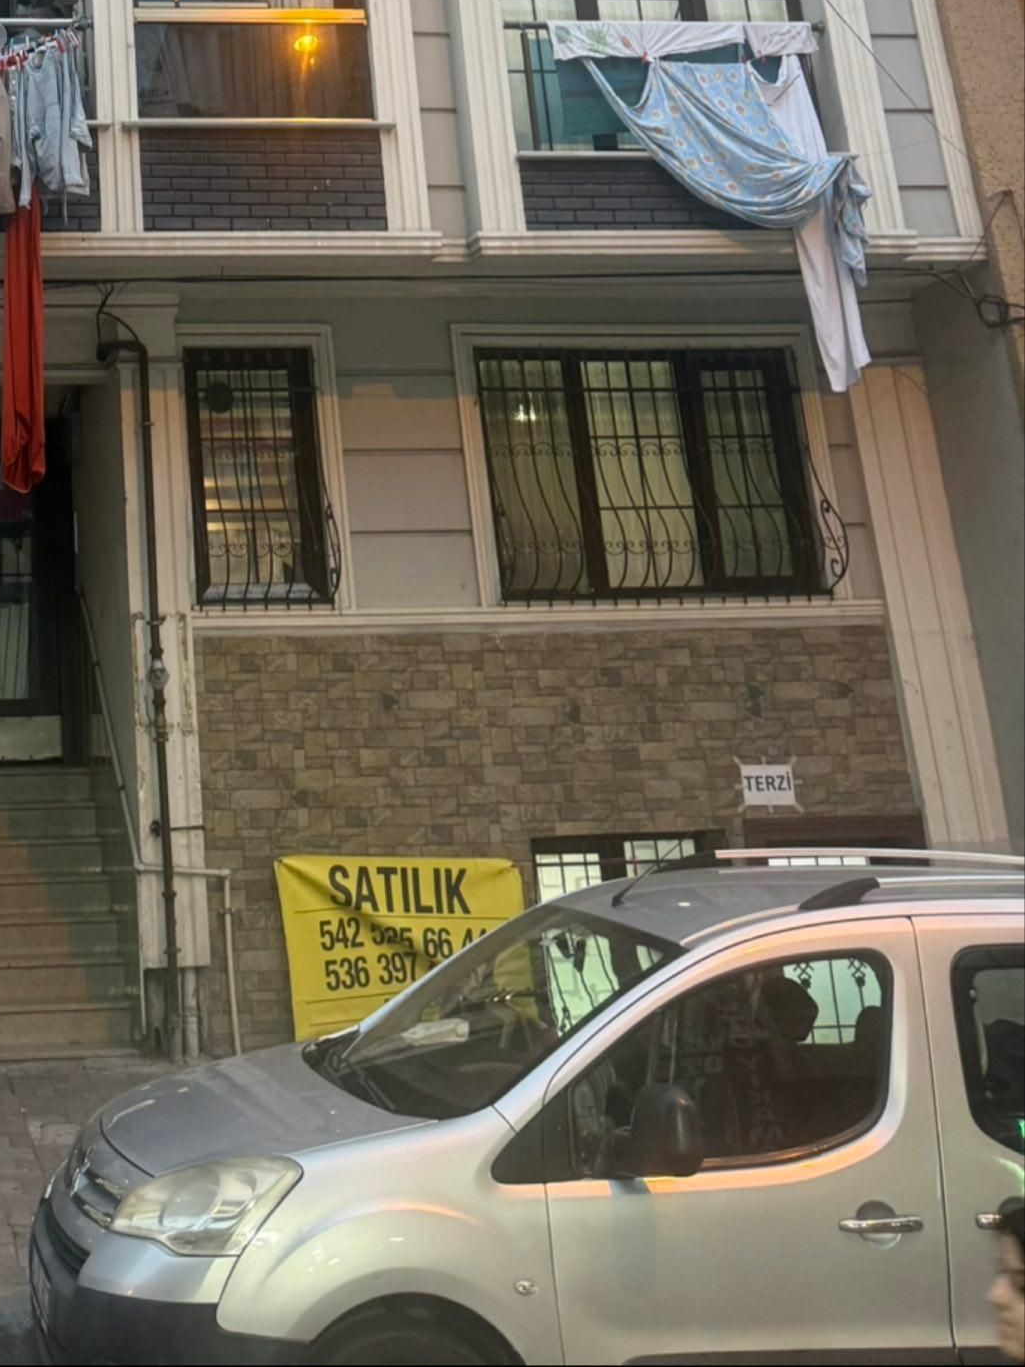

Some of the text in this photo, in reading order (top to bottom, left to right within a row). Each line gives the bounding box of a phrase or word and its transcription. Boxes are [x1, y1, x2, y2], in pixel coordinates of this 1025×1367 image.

[744, 771, 792, 792] TERZİ
[328, 864, 471, 915] SATILIK
[319, 918, 364, 952] 542
[423, 927, 454, 959] 66
[324, 951, 418, 992] 536 397
